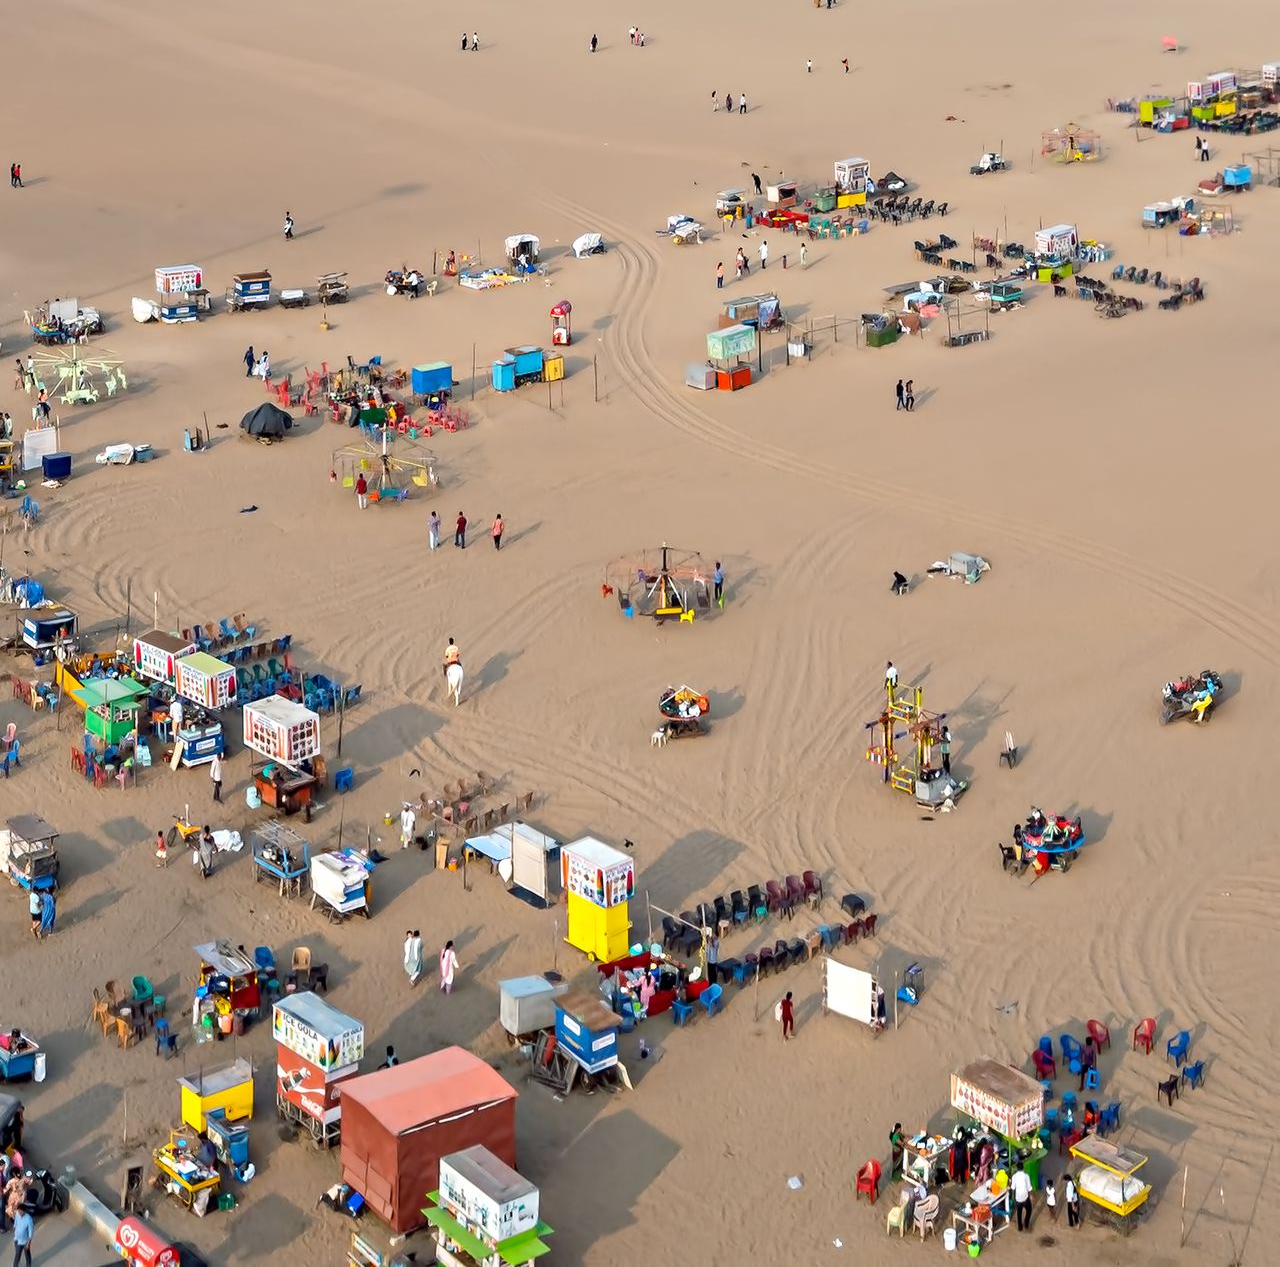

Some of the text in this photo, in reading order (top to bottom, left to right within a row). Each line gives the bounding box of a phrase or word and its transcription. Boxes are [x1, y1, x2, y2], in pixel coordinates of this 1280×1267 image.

[283, 1013, 318, 1041] ICE GOLA
[351, 1026, 363, 1035] GOLA
